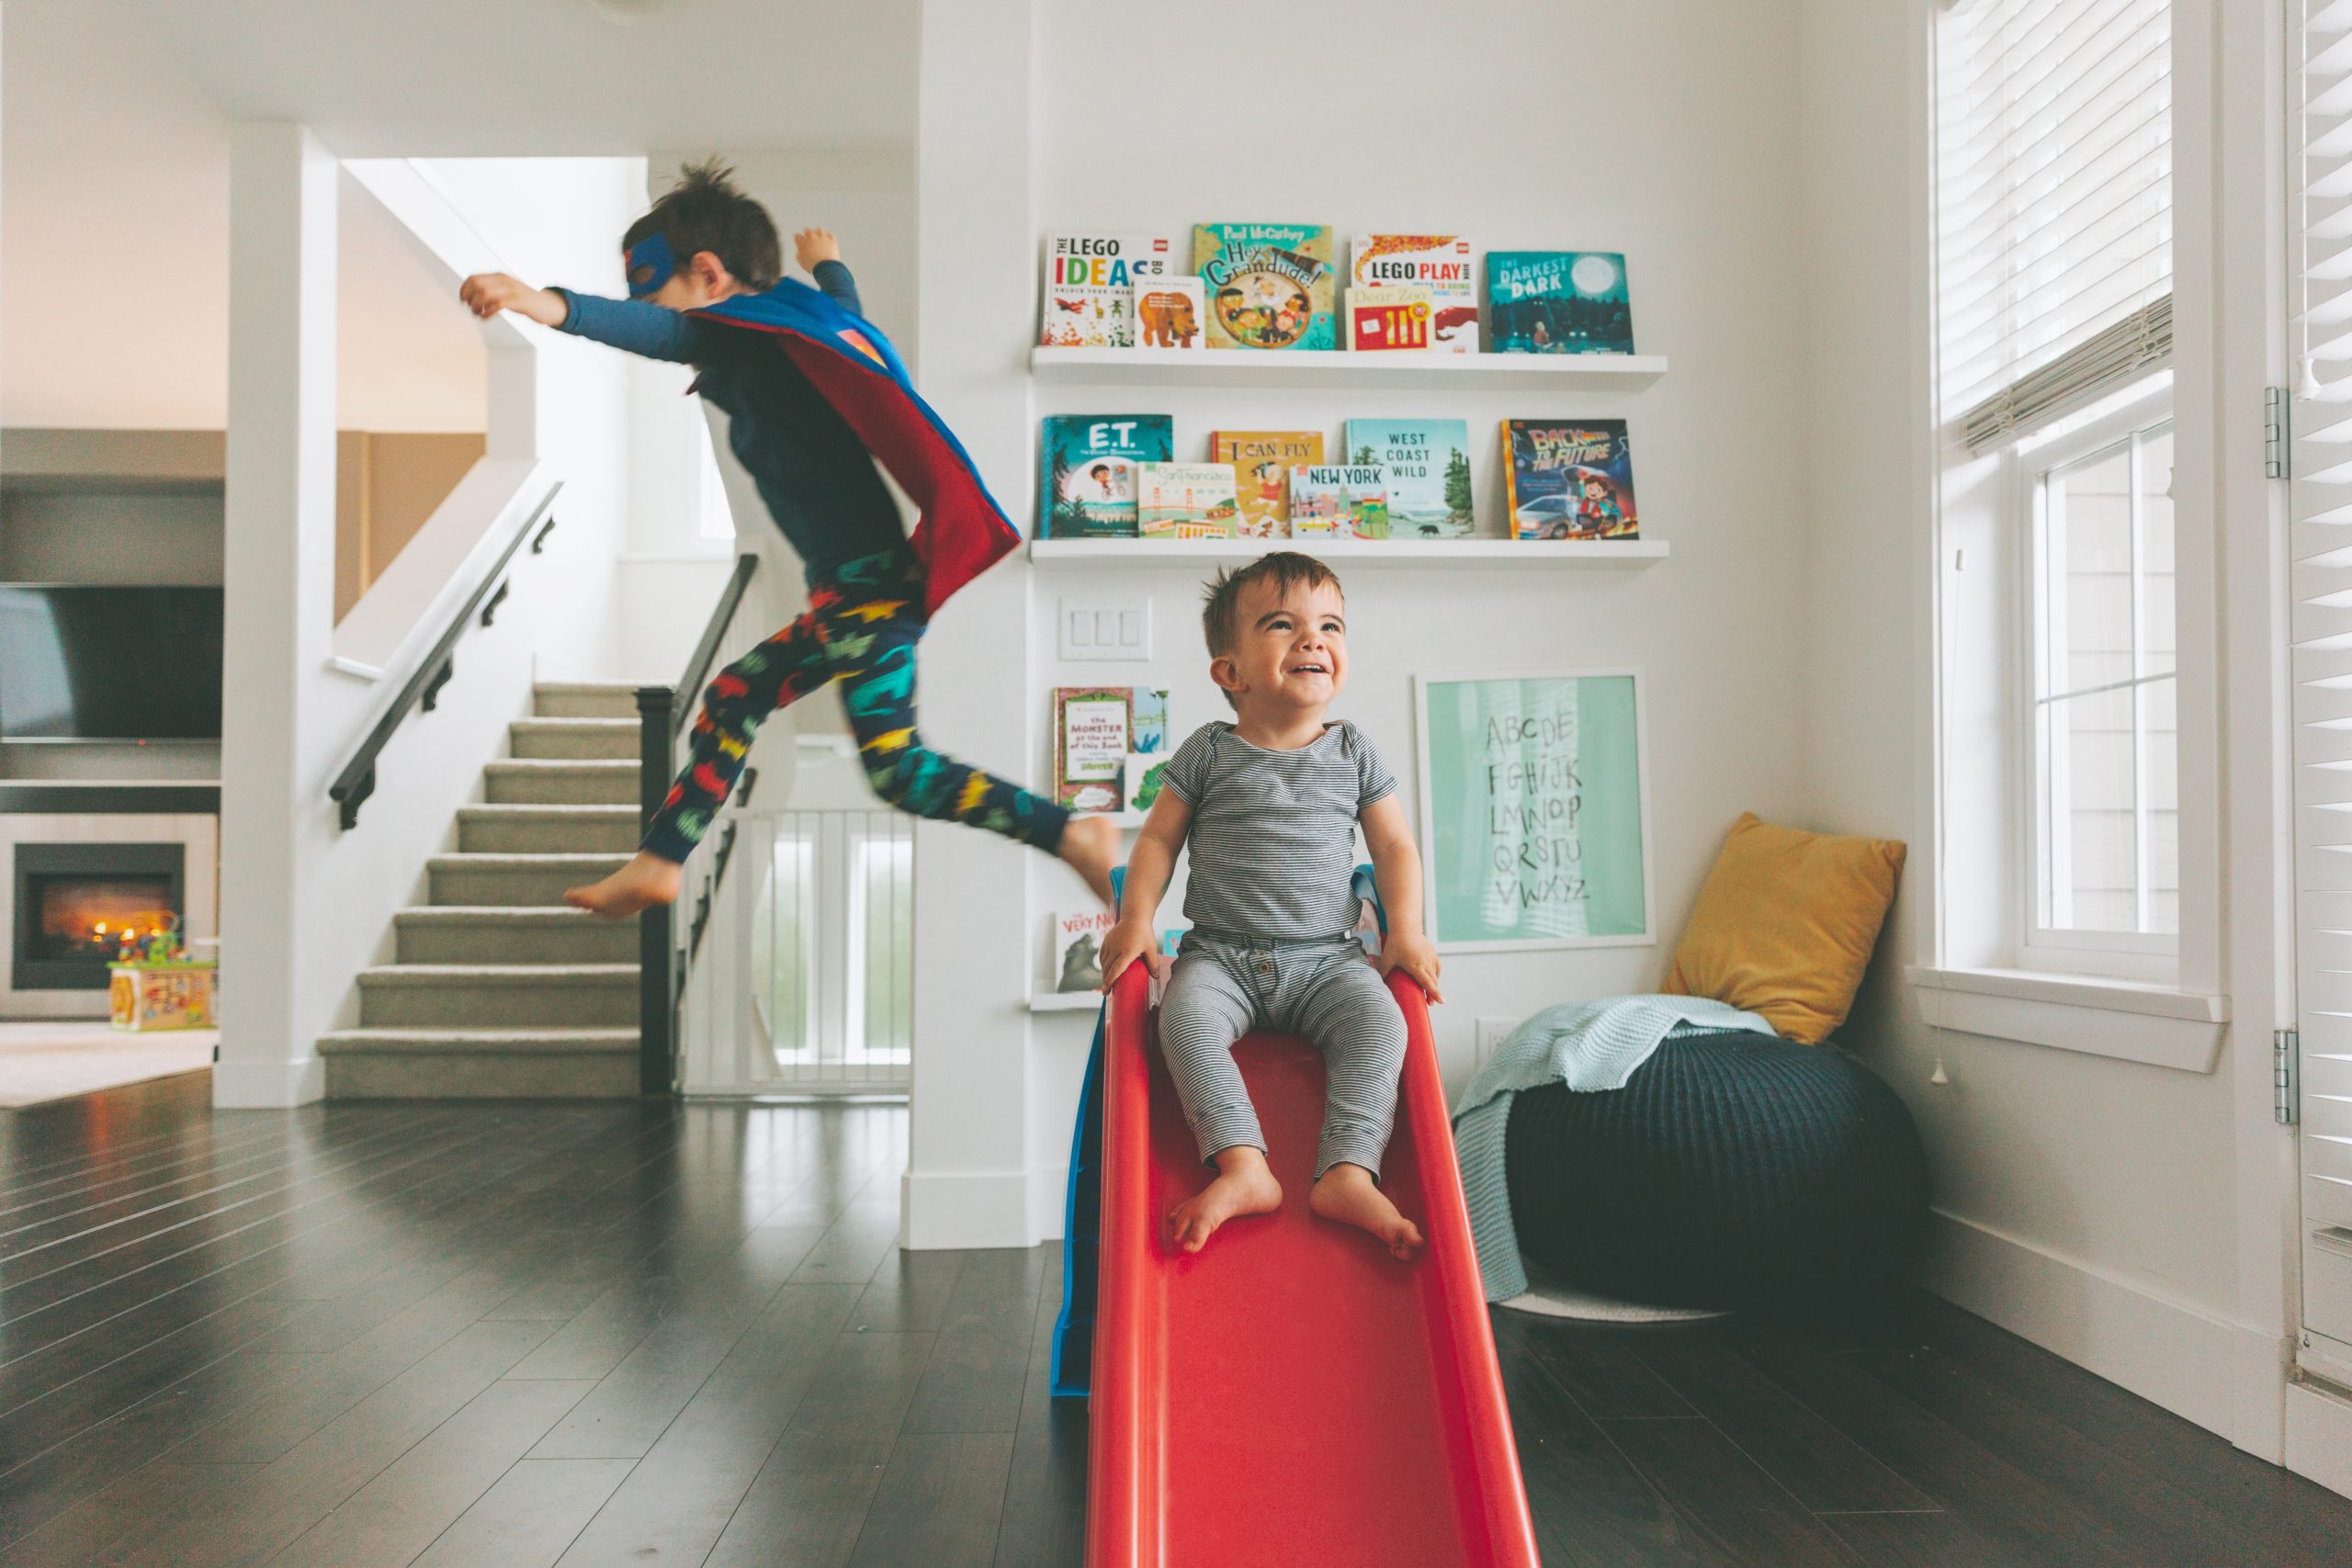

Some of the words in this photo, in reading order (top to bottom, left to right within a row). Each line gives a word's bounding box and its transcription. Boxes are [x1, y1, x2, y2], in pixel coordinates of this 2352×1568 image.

[1224, 226, 1247, 239] Paul
[1250, 226, 1304, 243] McCartney
[1057, 239, 1067, 254] THE
[1070, 239, 1120, 255] LEGO
[1226, 242, 1261, 263] Hey
[1205, 253, 1321, 288] Grandude!
[1372, 262, 1415, 279] LEGO
[1419, 263, 1461, 279] PLAY
[1500, 257, 1567, 283] DARKEST
[1354, 290, 1392, 302] Dear
[1396, 288, 1426, 301] Zoo
[1511, 273, 1562, 299] DARK
[1089, 422, 1137, 448] E.T.
[1389, 434, 1427, 445] WEST
[1528, 429, 1588, 450] BACK
[1232, 442, 1239, 460] I
[1246, 444, 1275, 457] CAN
[1285, 444, 1312, 457] FLY
[1386, 450, 1430, 461] COAST
[1554, 443, 1611, 468] FUTURE
[1310, 468, 1340, 484] NEW
[1344, 468, 1382, 484] YORK
[1392, 467, 1427, 478] WILD
[1487, 712, 1574, 757] ABCDE
[1491, 795, 1581, 835] LMNOP
[1494, 835, 1581, 876] QRSTU
[1496, 874, 1590, 908] VWXYZ
[1063, 917, 1092, 932] VERY
